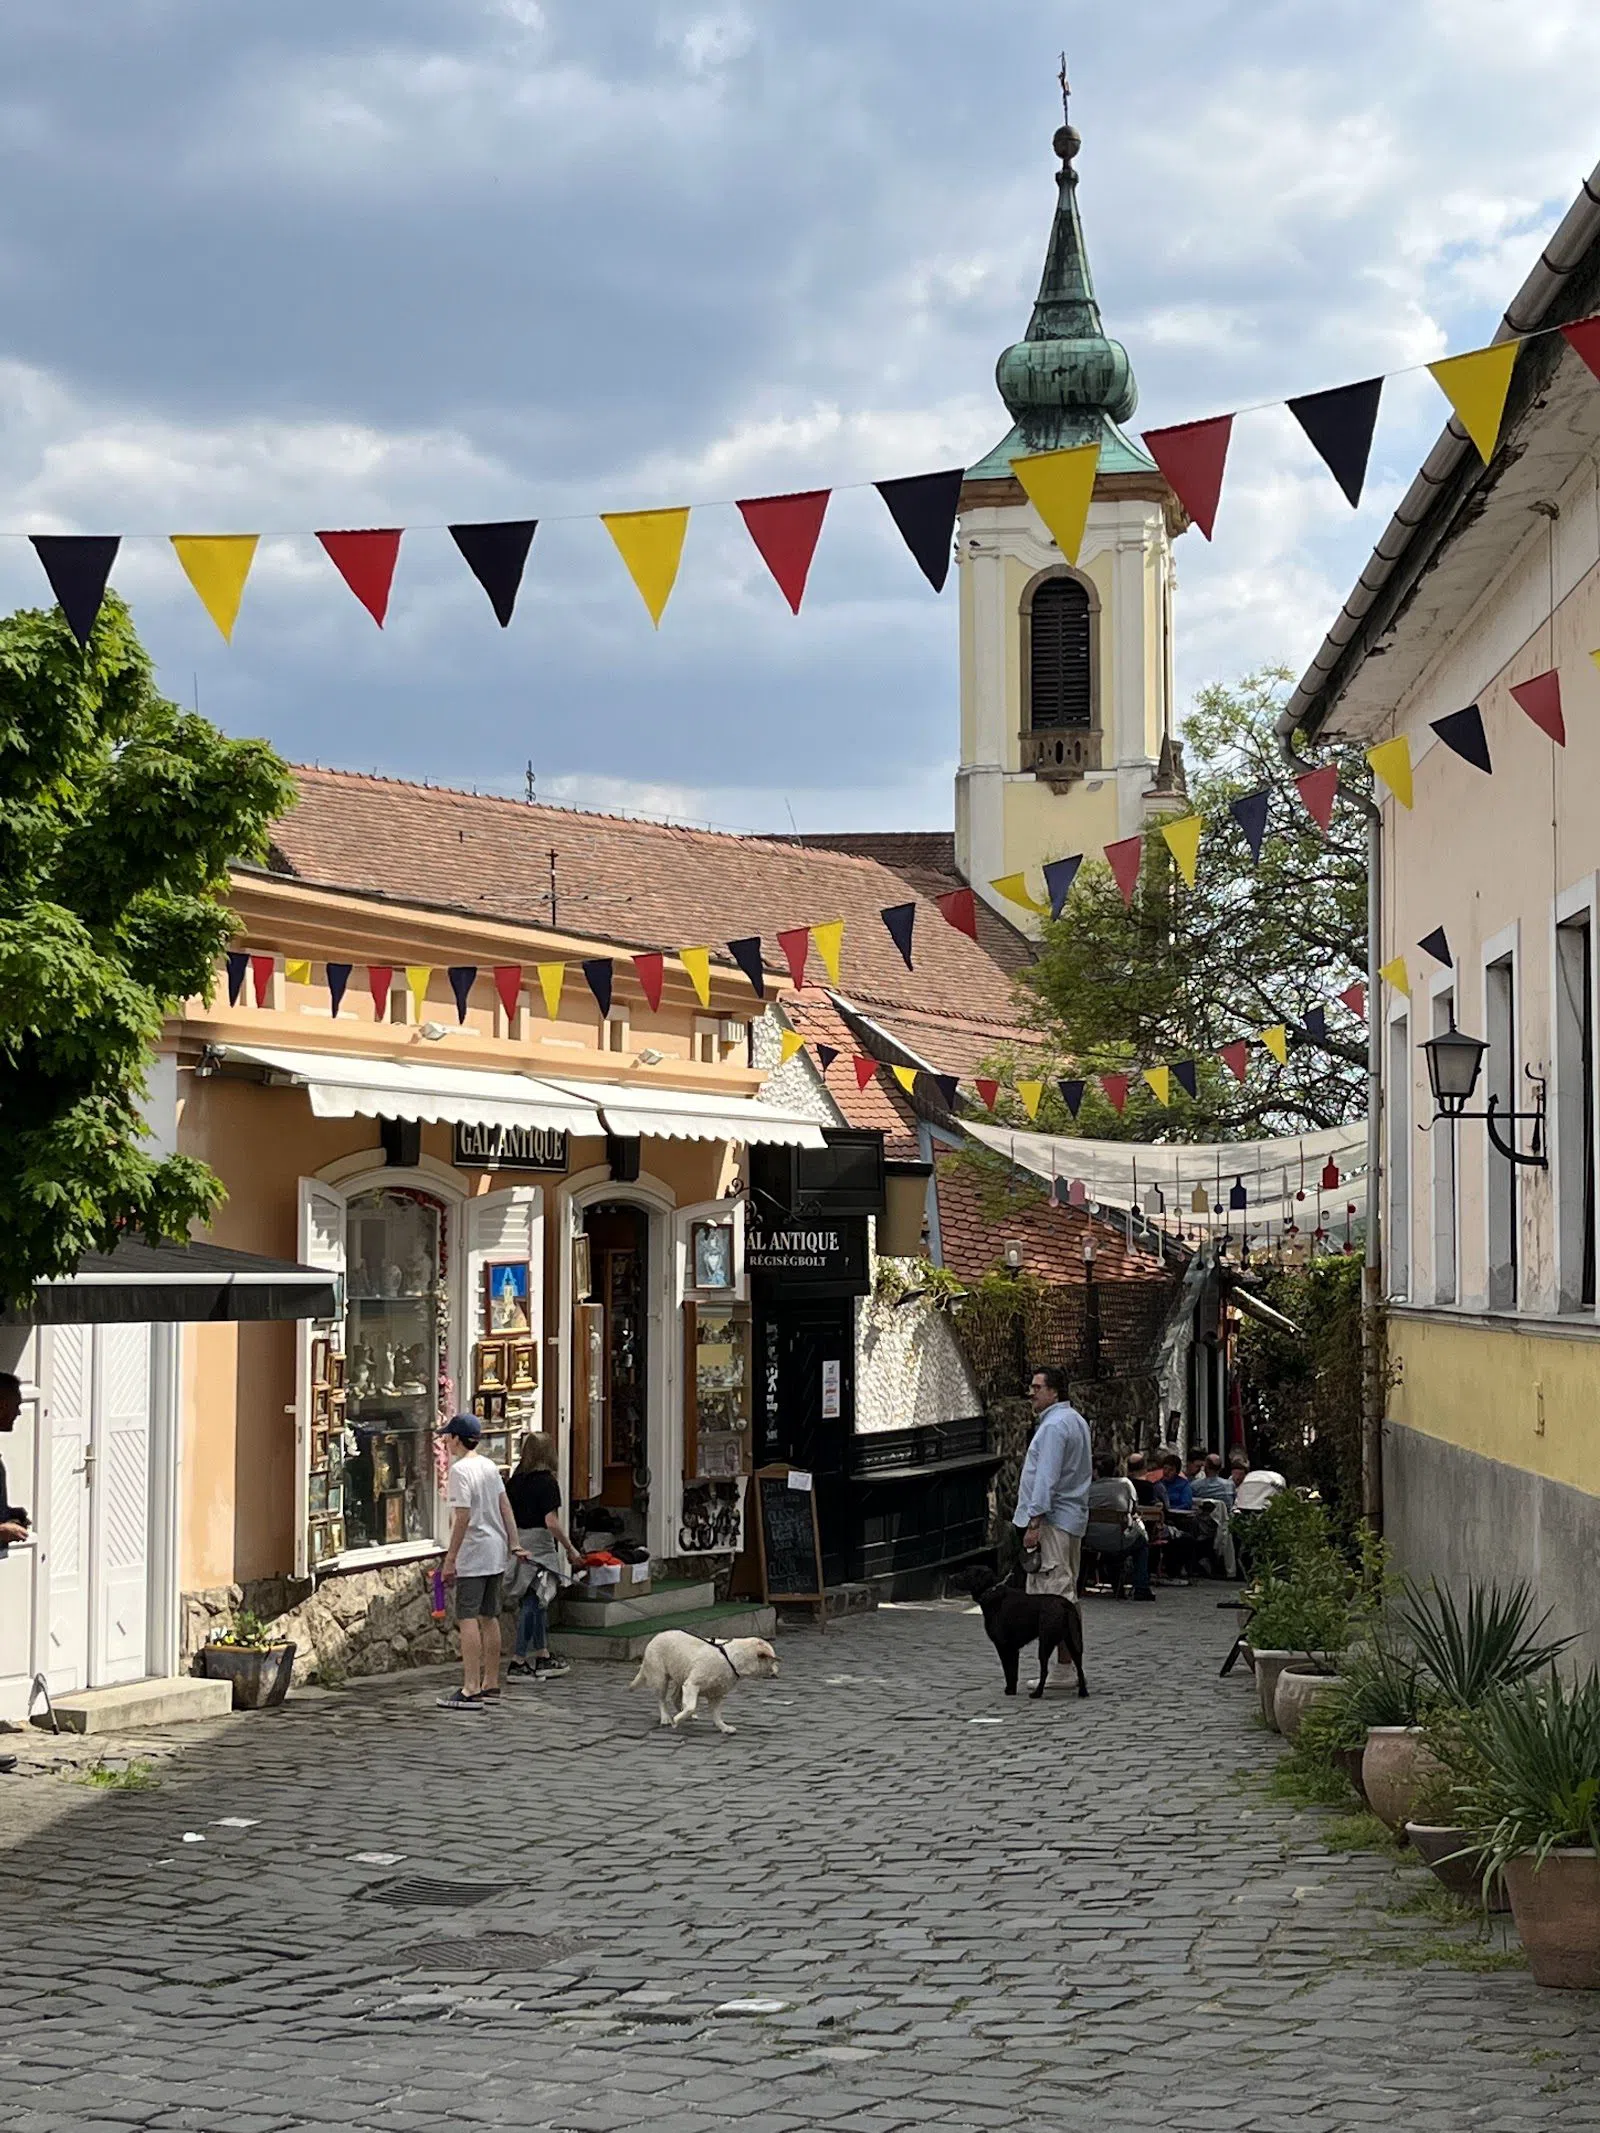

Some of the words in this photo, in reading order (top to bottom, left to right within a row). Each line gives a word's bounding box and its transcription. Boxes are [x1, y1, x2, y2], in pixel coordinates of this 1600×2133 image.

[497, 1127, 563, 1164] ANTIQUE
[744, 1226, 766, 1250] ÁL
[769, 1231, 840, 1253] ANTIQUE
